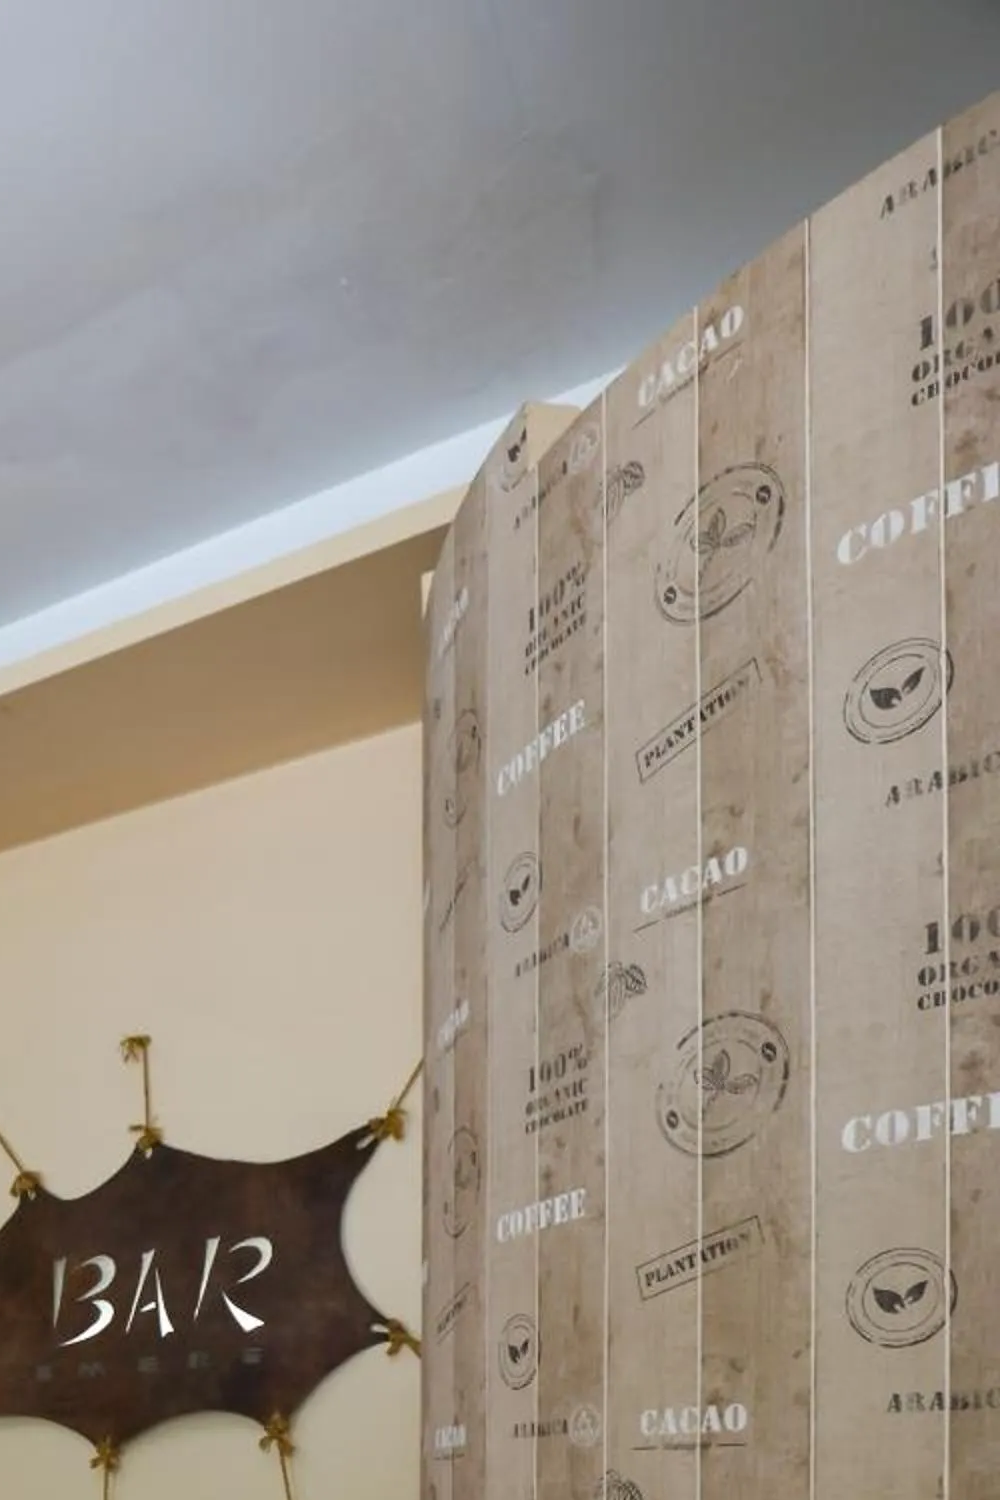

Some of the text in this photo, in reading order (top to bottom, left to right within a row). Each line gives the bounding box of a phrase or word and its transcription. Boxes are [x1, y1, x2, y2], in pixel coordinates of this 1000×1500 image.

[637, 304, 744, 407] CACAO
[496, 698, 585, 797] COFFEE
[640, 845, 748, 914] CACAO
[497, 1187, 586, 1243] COFFEE
[53, 1235, 273, 1346] BAR
[640, 1403, 748, 1436] CACAO
